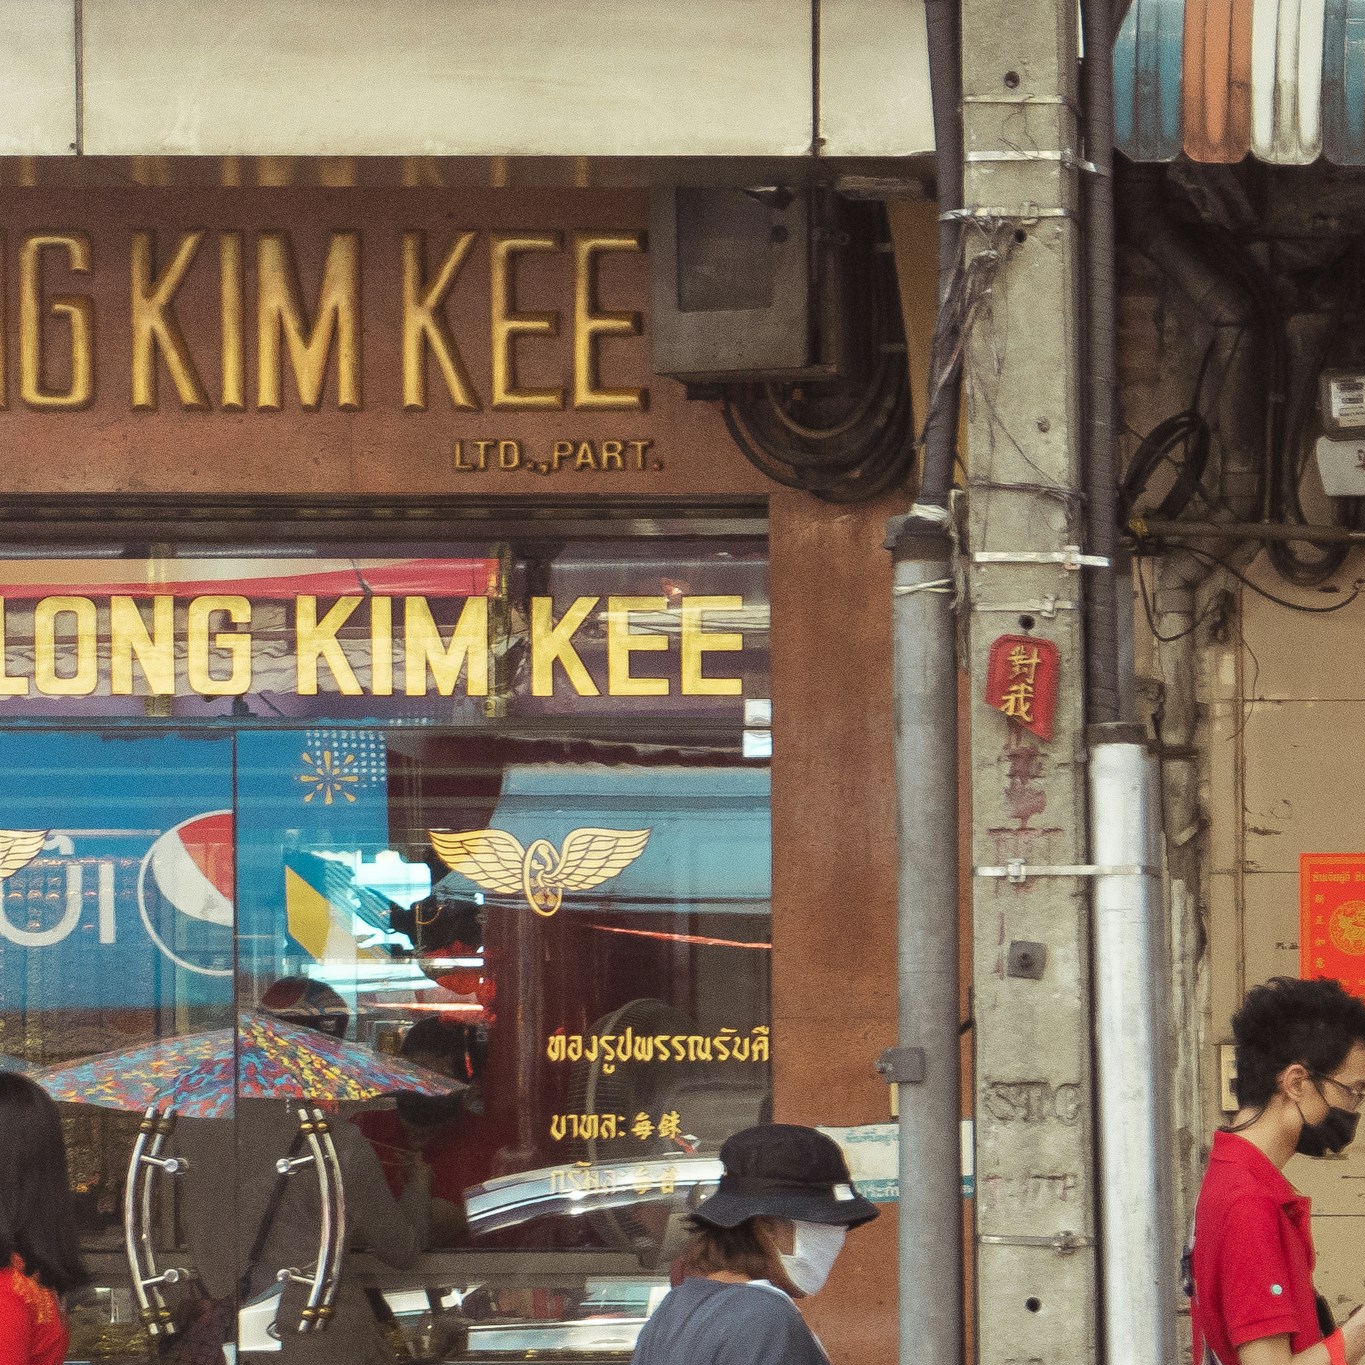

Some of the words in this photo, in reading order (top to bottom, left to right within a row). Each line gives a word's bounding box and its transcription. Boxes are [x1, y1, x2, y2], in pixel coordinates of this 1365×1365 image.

[131, 230, 363, 411] KIM
[402, 230, 648, 411] KEE
[295, 595, 490, 698] KIM
[531, 594, 744, 698] KEE
[550, 1113, 627, 1141] บาทละ
